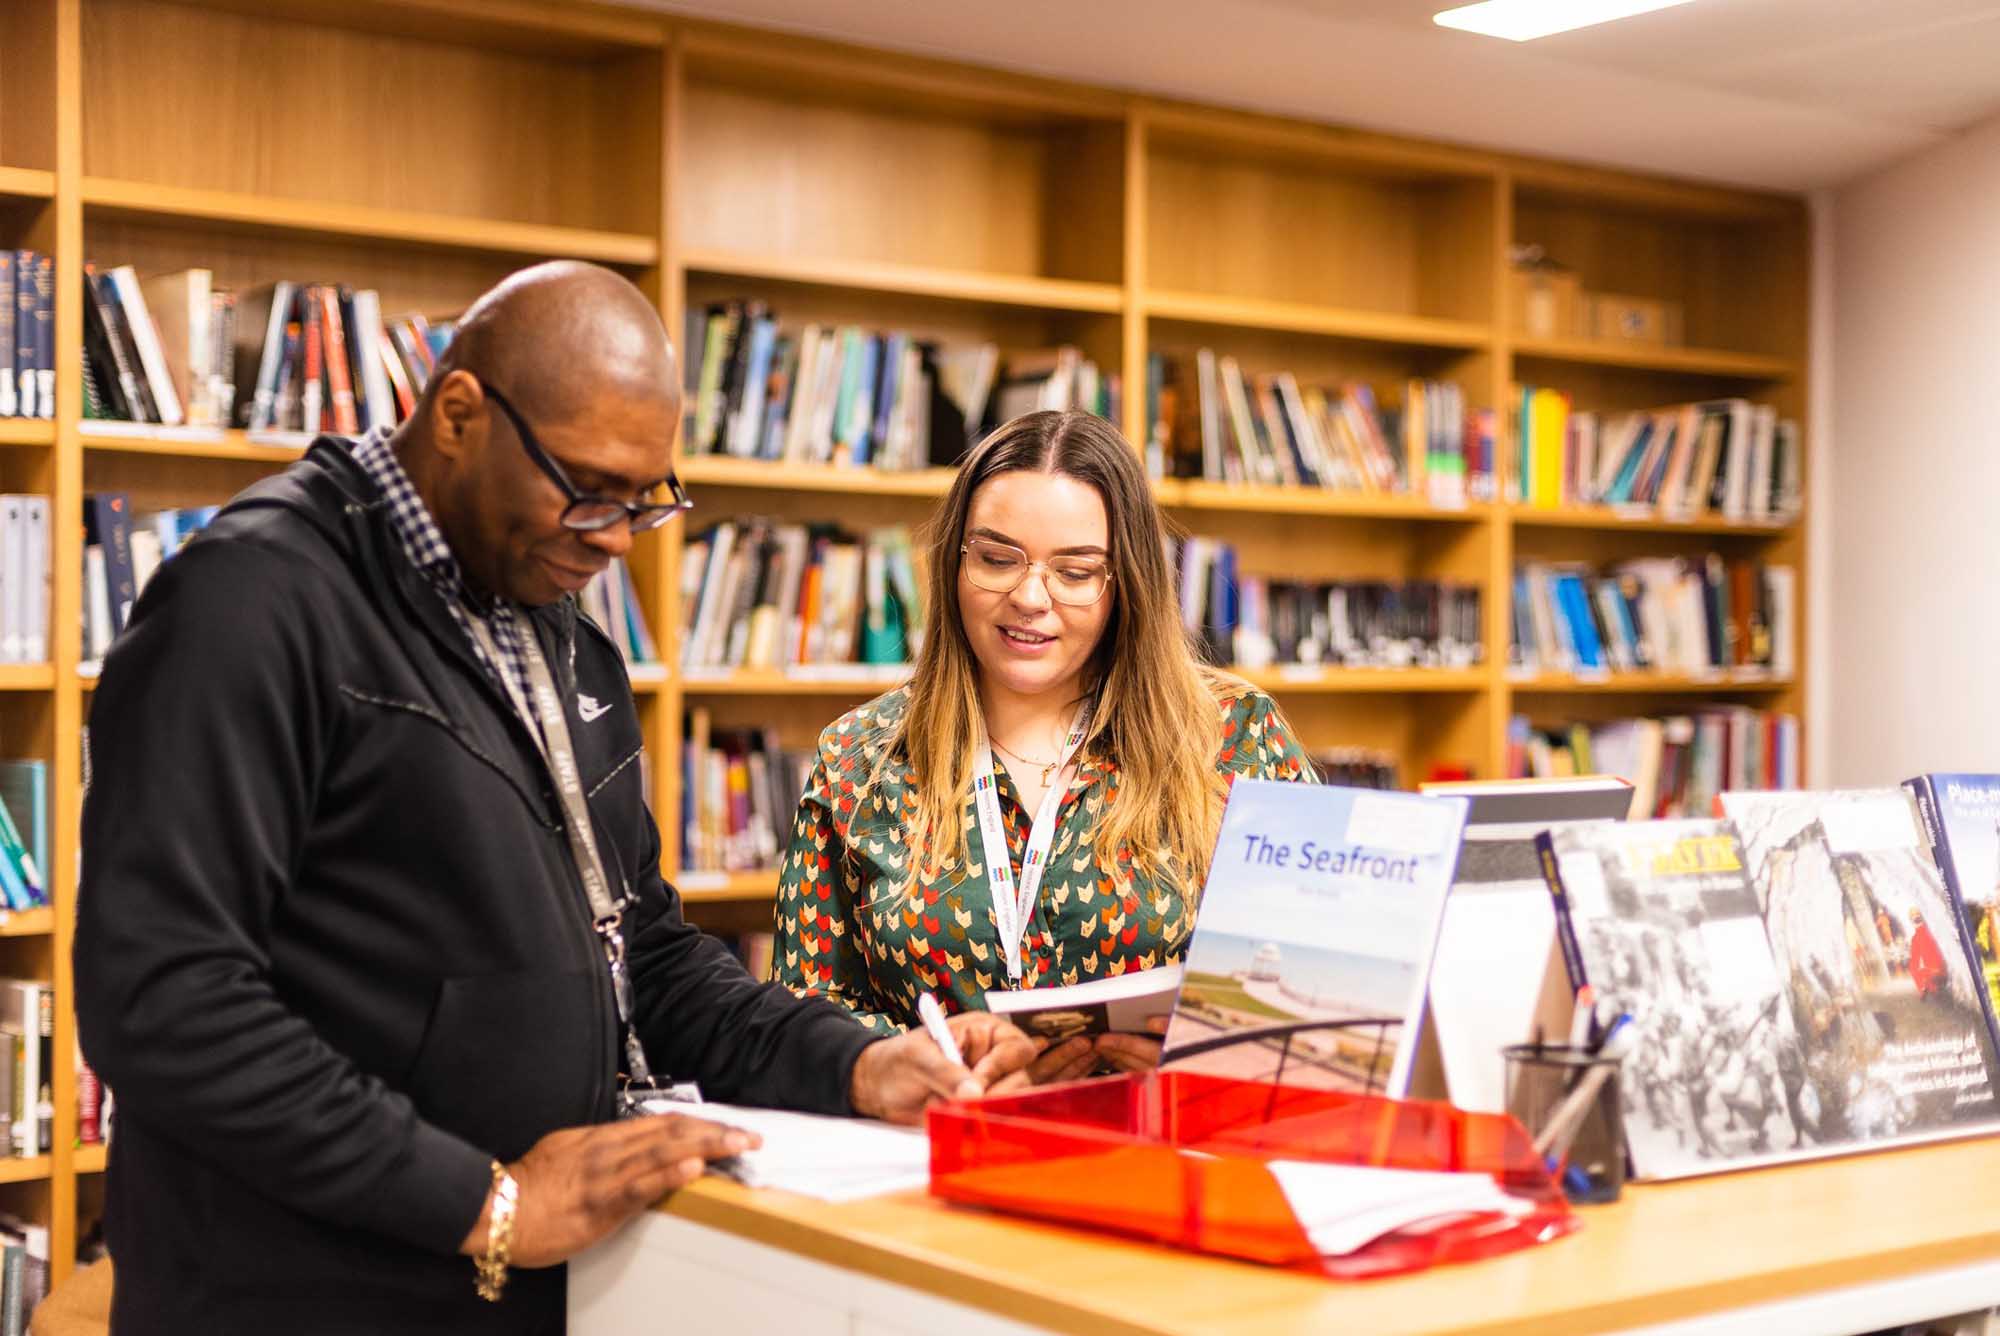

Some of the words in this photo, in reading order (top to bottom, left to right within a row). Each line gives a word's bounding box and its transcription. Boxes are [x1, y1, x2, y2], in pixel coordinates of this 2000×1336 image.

[554, 750, 578, 793] STAFF
[1244, 834, 1290, 867] The
[1298, 841, 1419, 884] Seafront
